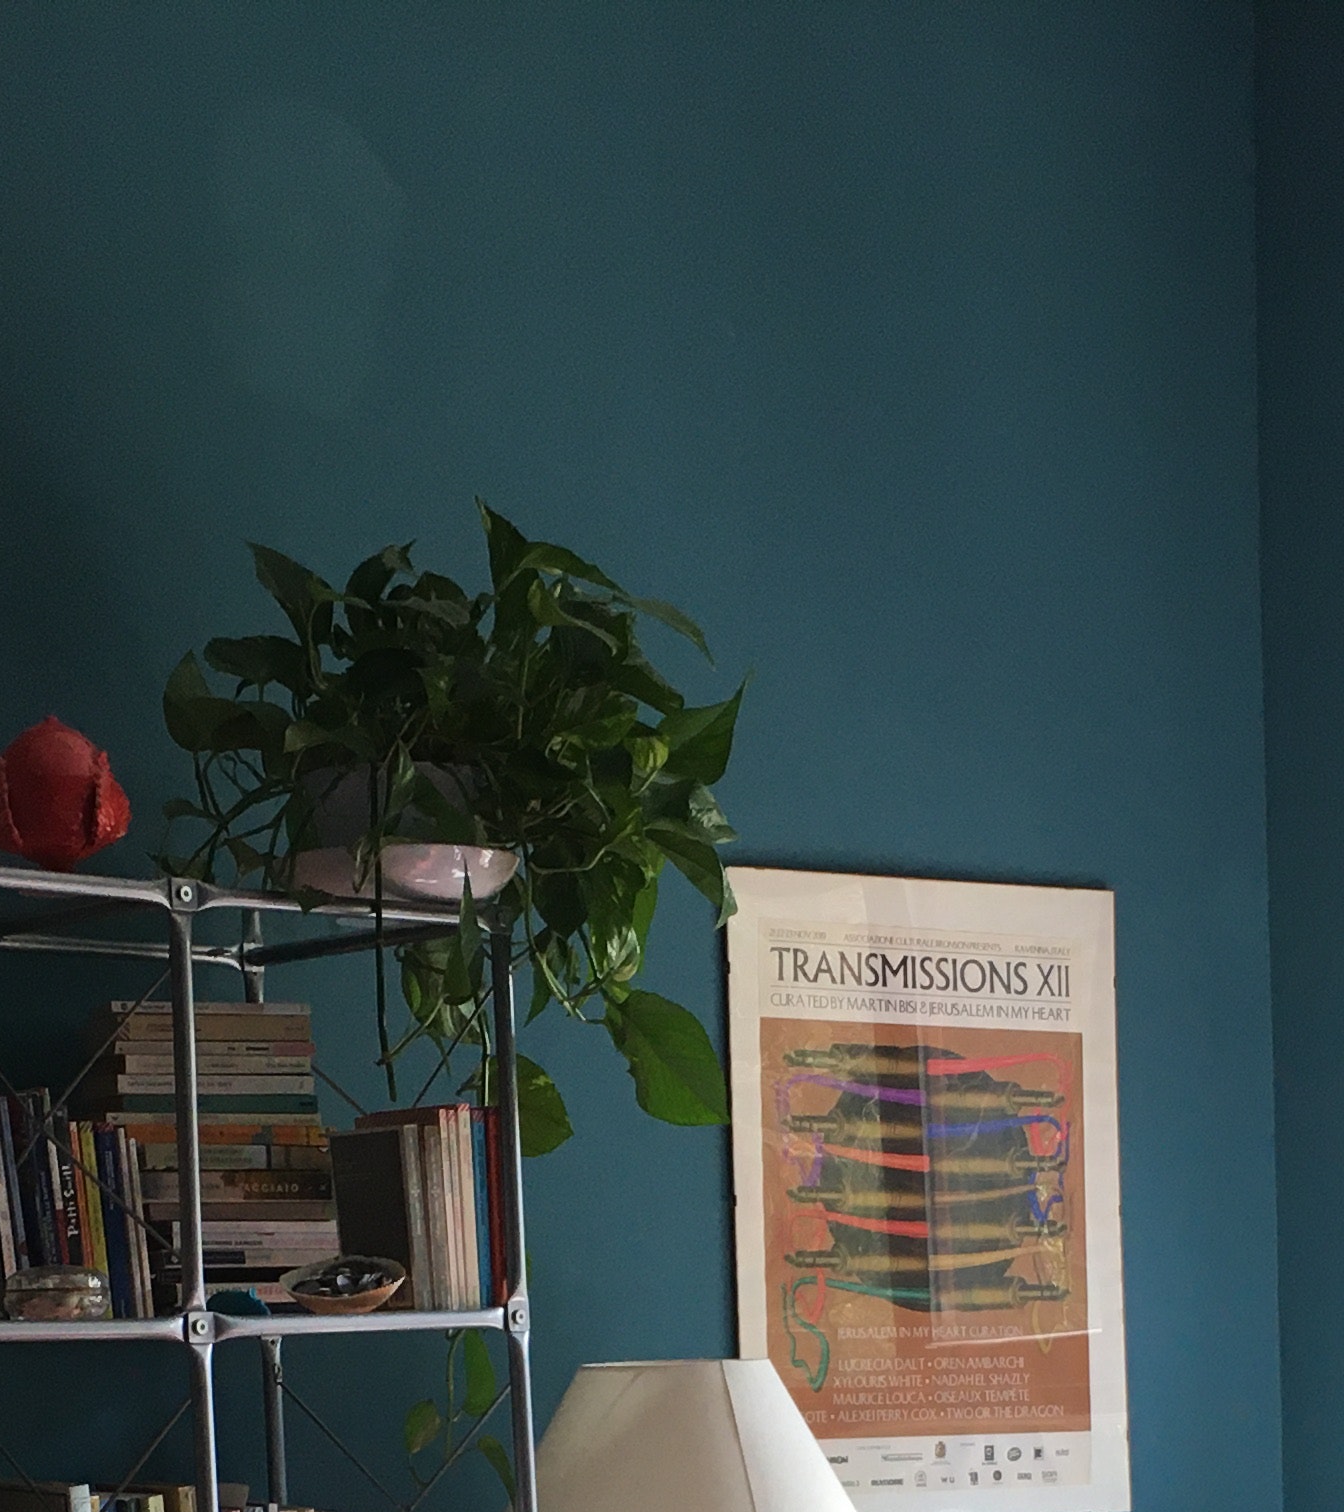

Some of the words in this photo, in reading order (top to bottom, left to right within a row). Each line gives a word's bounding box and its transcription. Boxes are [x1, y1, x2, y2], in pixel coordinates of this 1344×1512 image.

[770, 946, 1028, 996] TRANSMISSIONS
[1036, 963, 1070, 998] XII
[770, 993, 830, 1010] CURATED
[830, 996, 846, 1010] BY
[846, 996, 899, 1013] MARTIN
[899, 999, 918, 1013] BISI
[928, 1001, 997, 1018] JERUSALEM
[997, 1005, 1011, 1018] IN
[1011, 1005, 1031, 1019] MY
[1031, 1007, 1071, 1021] HEART
[65, 1200, 80, 1238] Patti
[837, 1326, 897, 1339] JERUSALEM
[898, 1327, 911, 1337] IN
[912, 1326, 930, 1338] MY
[931, 1326, 967, 1337] HEART
[969, 1325, 1024, 1338] CURATION
[837, 1359, 894, 1372] LUCRECIA
[894, 1358, 926, 1369] DALT
[934, 1357, 965, 1369] OREN
[965, 1356, 1025, 1369] AMBARCHI
[890, 1374, 923, 1387] WHITE
[931, 1374, 975, 1387] NADAH
[975, 1374, 988, 1386] EL
[988, 1373, 1031, 1386] SHAZLY
[833, 1392, 886, 1406] MAURICE
[885, 1391, 926, 1404] LOUCA
[934, 1390, 982, 1403] OISEAUX
[837, 1408, 876, 1422] ALEXEI
[875, 1407, 910, 1421] PERRY
[909, 1407, 937, 1420] COX
[946, 1406, 974, 1419] TWO
[974, 1406, 994, 1418] OR
[994, 1406, 1015, 1418] THE
[1014, 1404, 1064, 1418] DRAGON
